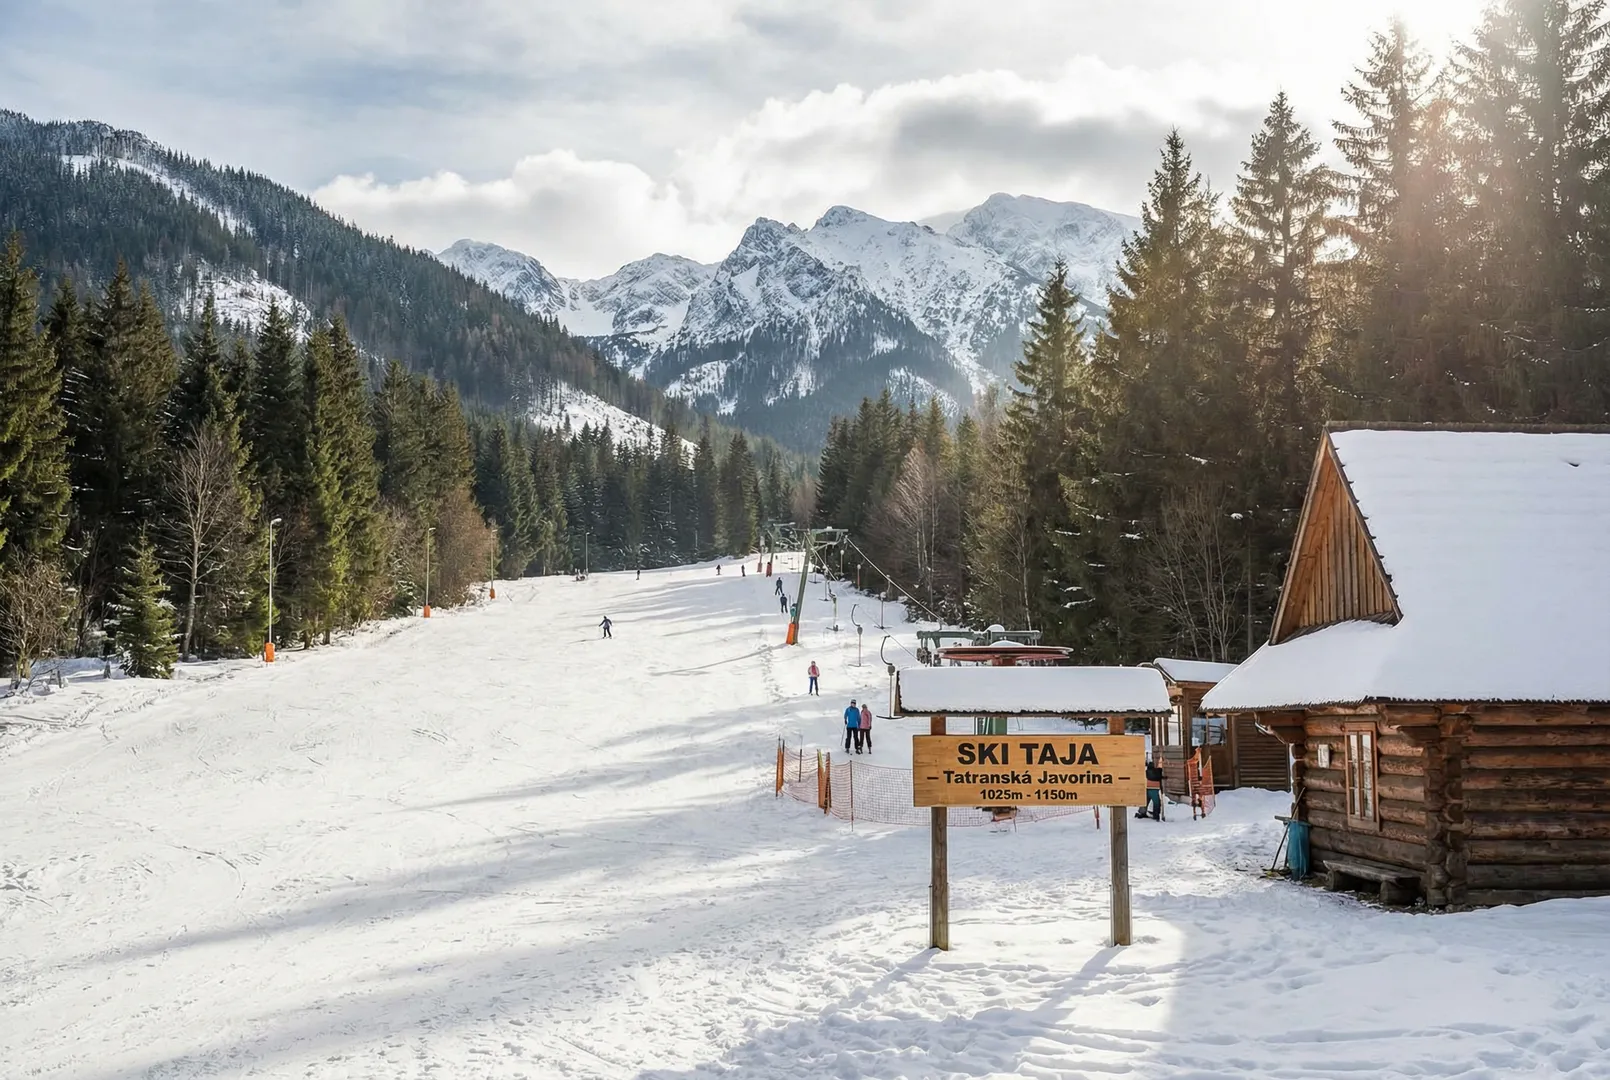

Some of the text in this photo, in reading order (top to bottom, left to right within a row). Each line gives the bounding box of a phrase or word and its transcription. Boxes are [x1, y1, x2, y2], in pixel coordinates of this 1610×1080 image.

[957, 742, 1099, 766] SKI TAJA
[943, 770, 1032, 785] Tatranská
[1037, 770, 1113, 785] Javorina
[979, 788, 1023, 800] 1025m
[1035, 788, 1078, 800] 1150m
